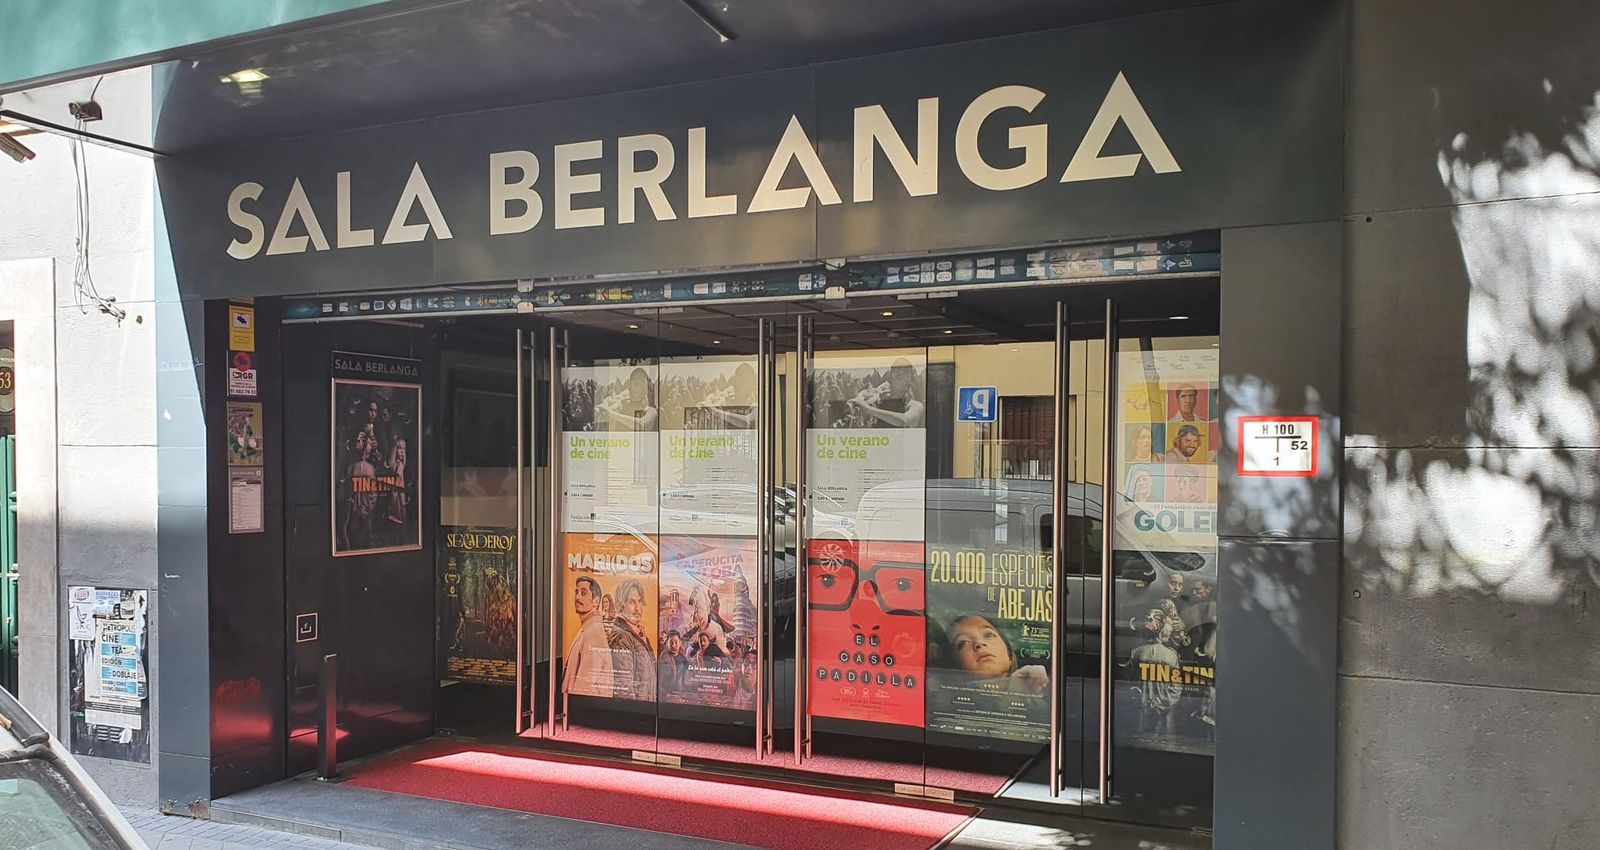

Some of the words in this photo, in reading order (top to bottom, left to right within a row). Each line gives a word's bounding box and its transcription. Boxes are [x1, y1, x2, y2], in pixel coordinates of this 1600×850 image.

[226, 161, 453, 260] SALA
[489, 70, 1182, 236] BERLANGA
[334, 359, 363, 371] SALA
[365, 361, 419, 376] BERLANGA
[1262, 424, 1269, 434] H
[1275, 424, 1295, 435] 100
[570, 436, 586, 448] Un
[589, 438, 631, 448] verano
[669, 435, 686, 446] Un
[689, 436, 736, 448] verano
[816, 433, 836, 446] Un
[840, 436, 890, 447] verano
[1291, 440, 1308, 450] 52
[570, 448, 584, 459] de
[587, 448, 612, 459] cine
[669, 447, 684, 458] de
[688, 447, 715, 458] cine
[816, 447, 834, 459] de
[838, 447, 868, 459] cine
[1273, 456, 1280, 466] 1
[447, 533, 516, 551] SECADEROS
[931, 550, 986, 585] 20.000
[992, 553, 1053, 589] ESPECIES
[987, 586, 996, 602] DE
[997, 587, 1053, 623] ABEJAS
[101, 634, 119, 643] CINE
[856, 635, 877, 647] EL
[840, 653, 893, 666] CASO
[112, 670, 137, 679] DOBLAJE
[819, 669, 913, 687] PADILLA
